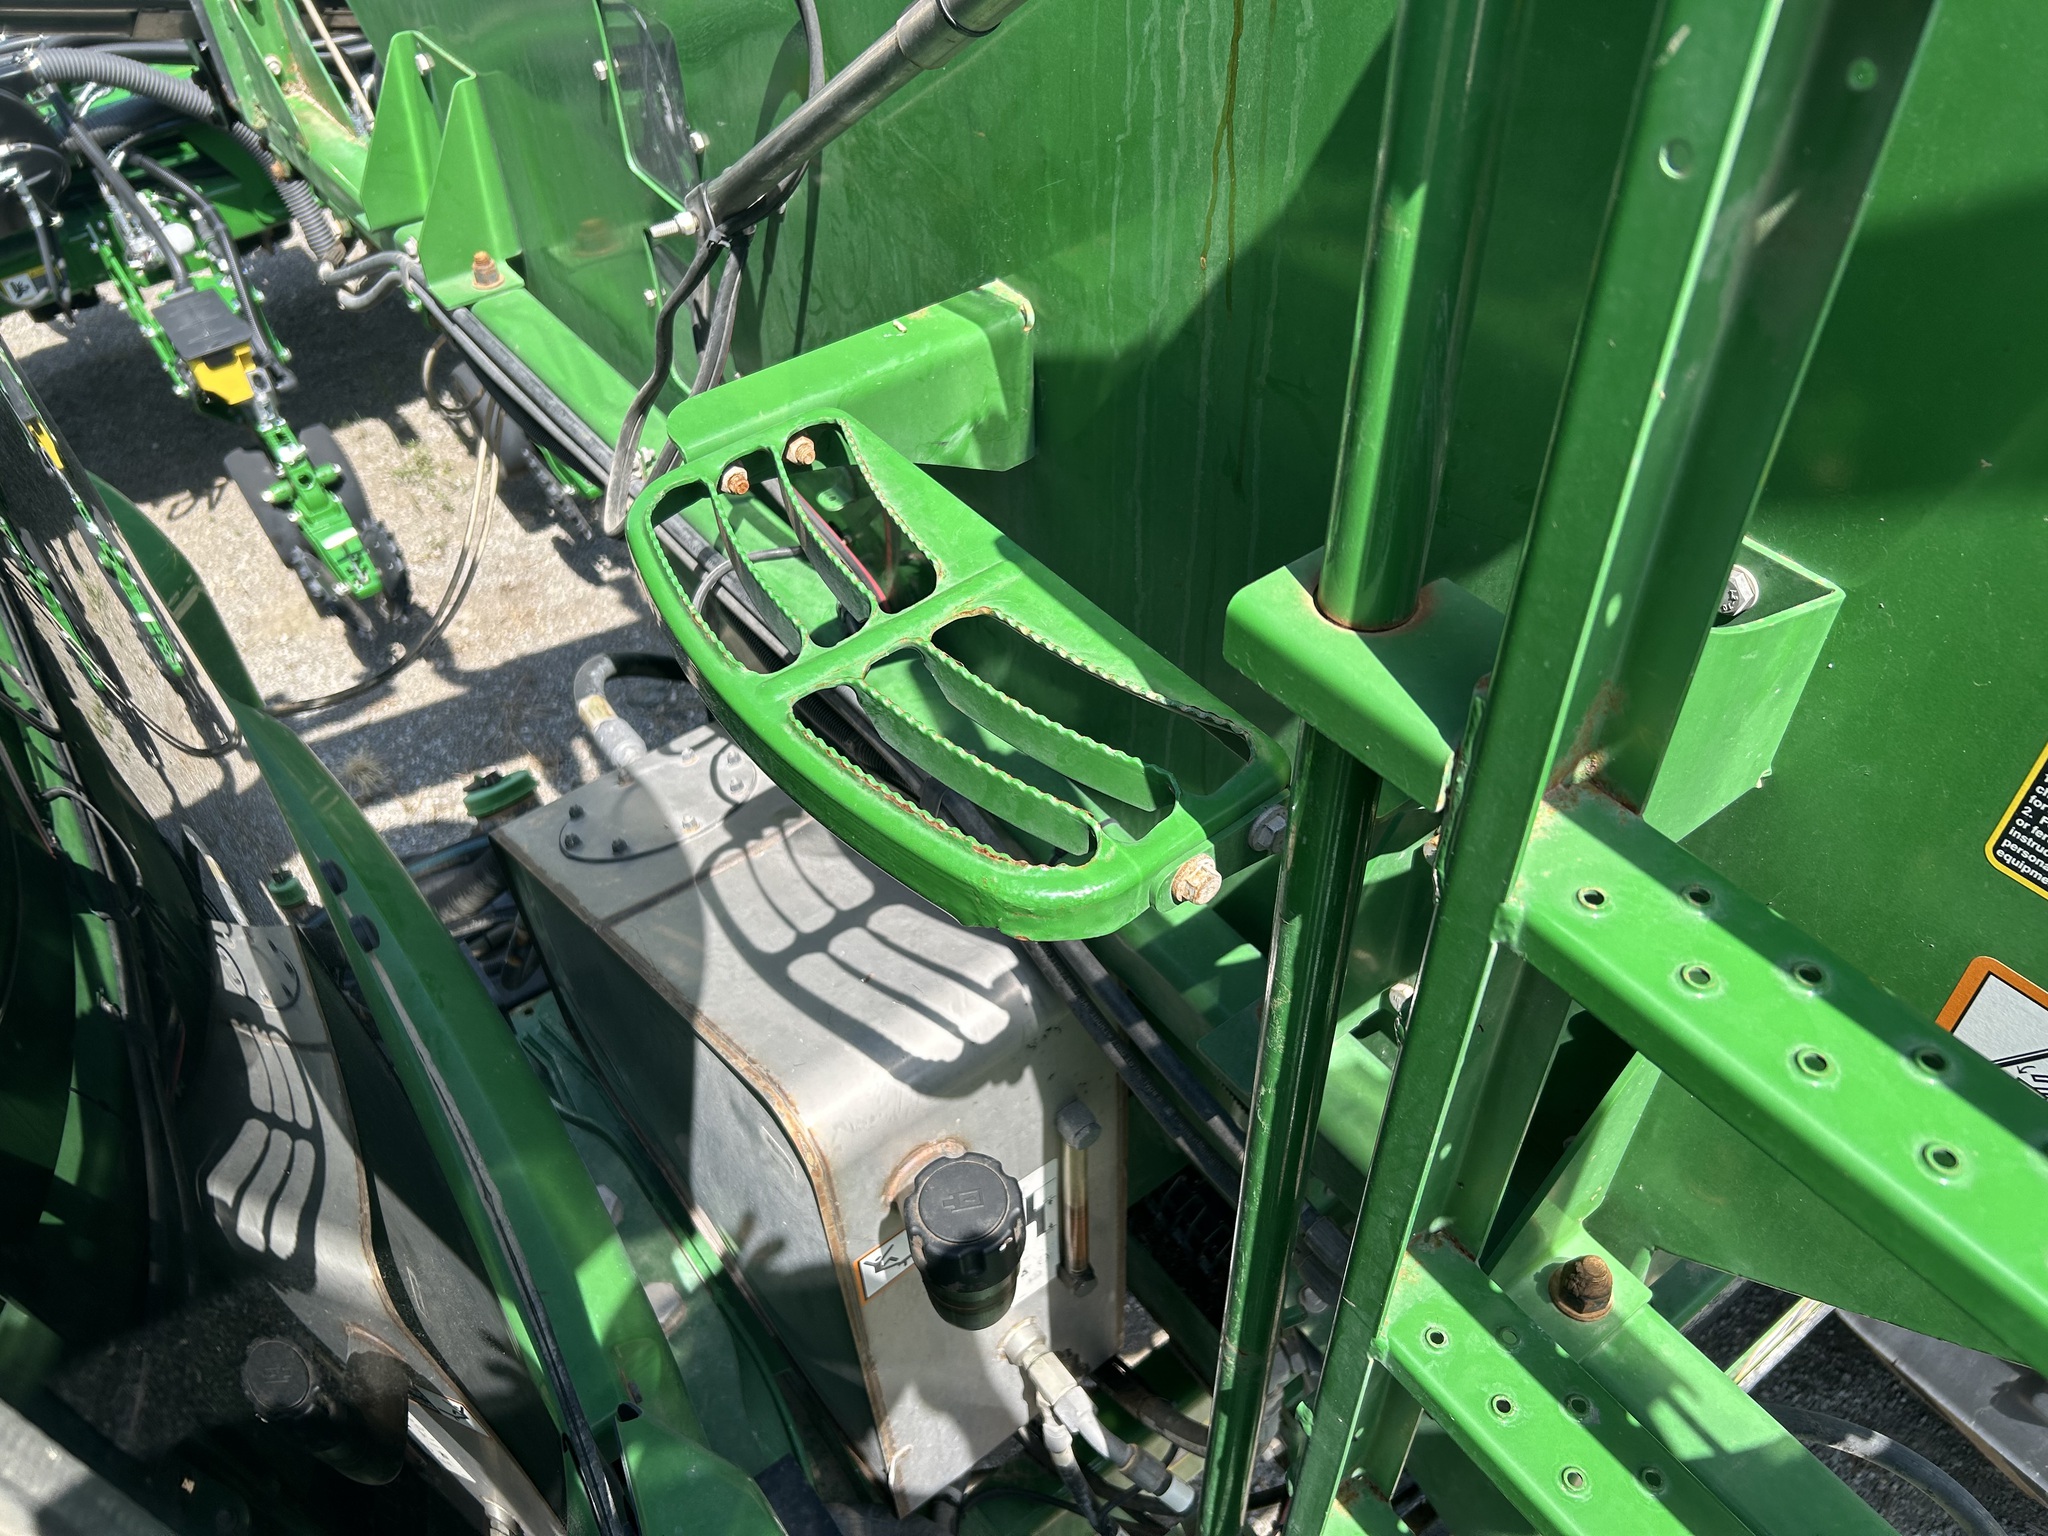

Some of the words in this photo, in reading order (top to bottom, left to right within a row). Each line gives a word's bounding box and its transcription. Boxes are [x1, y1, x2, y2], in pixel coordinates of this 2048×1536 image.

[2021, 805, 2033, 818] 2.
[2039, 815, 2048, 826] F
[2015, 818, 2031, 829] or
[2031, 825, 2048, 843] fer
[1996, 849, 2048, 885] equipme
